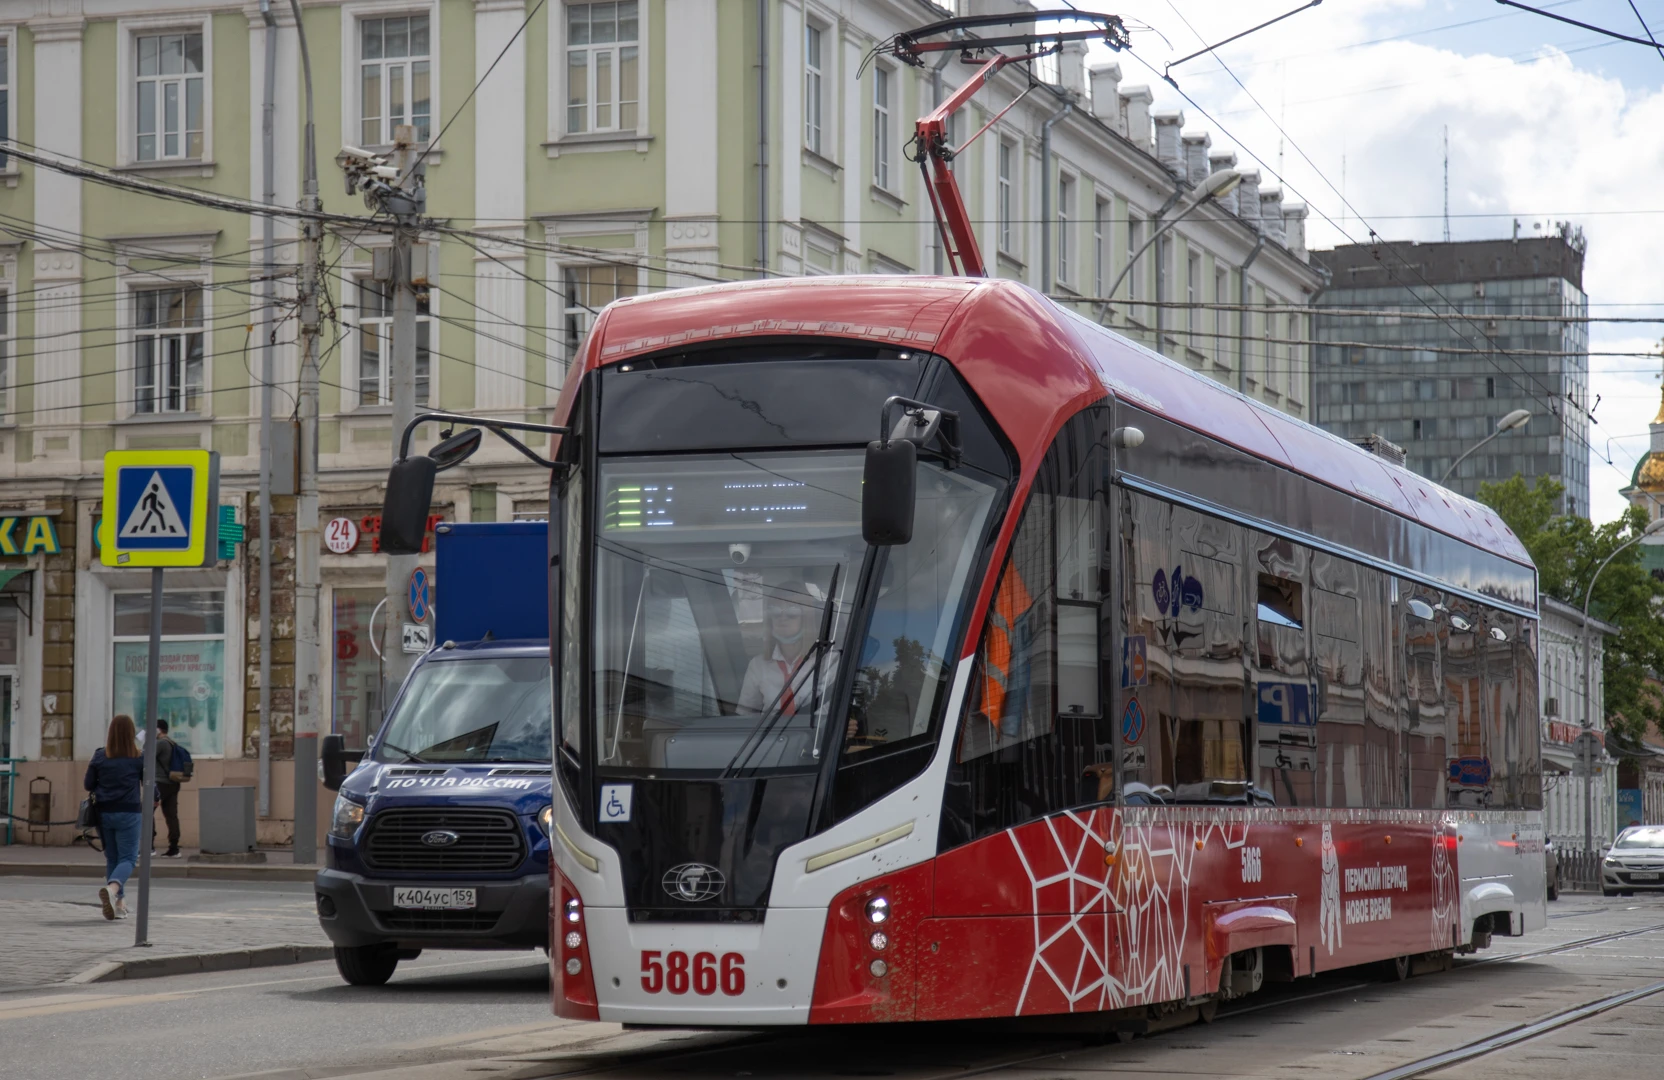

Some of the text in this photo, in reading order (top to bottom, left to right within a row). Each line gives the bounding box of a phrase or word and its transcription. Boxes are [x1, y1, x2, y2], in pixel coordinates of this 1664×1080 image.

[331, 520, 350, 541] 24
[329, 541, 351, 551] ЧАСА
[386, 777, 533, 790] ПОЧТА РОССИИ
[428, 834, 448, 844] Ford
[1241, 847, 1262, 883] 5866
[1345, 861, 1408, 893] ПЕРМСКИЙ ПЕРИОД
[452, 889, 473, 901] 159
[1345, 896, 1391, 925] НОВОЕ ВРЕМЯ
[641, 950, 746, 997] 5866
